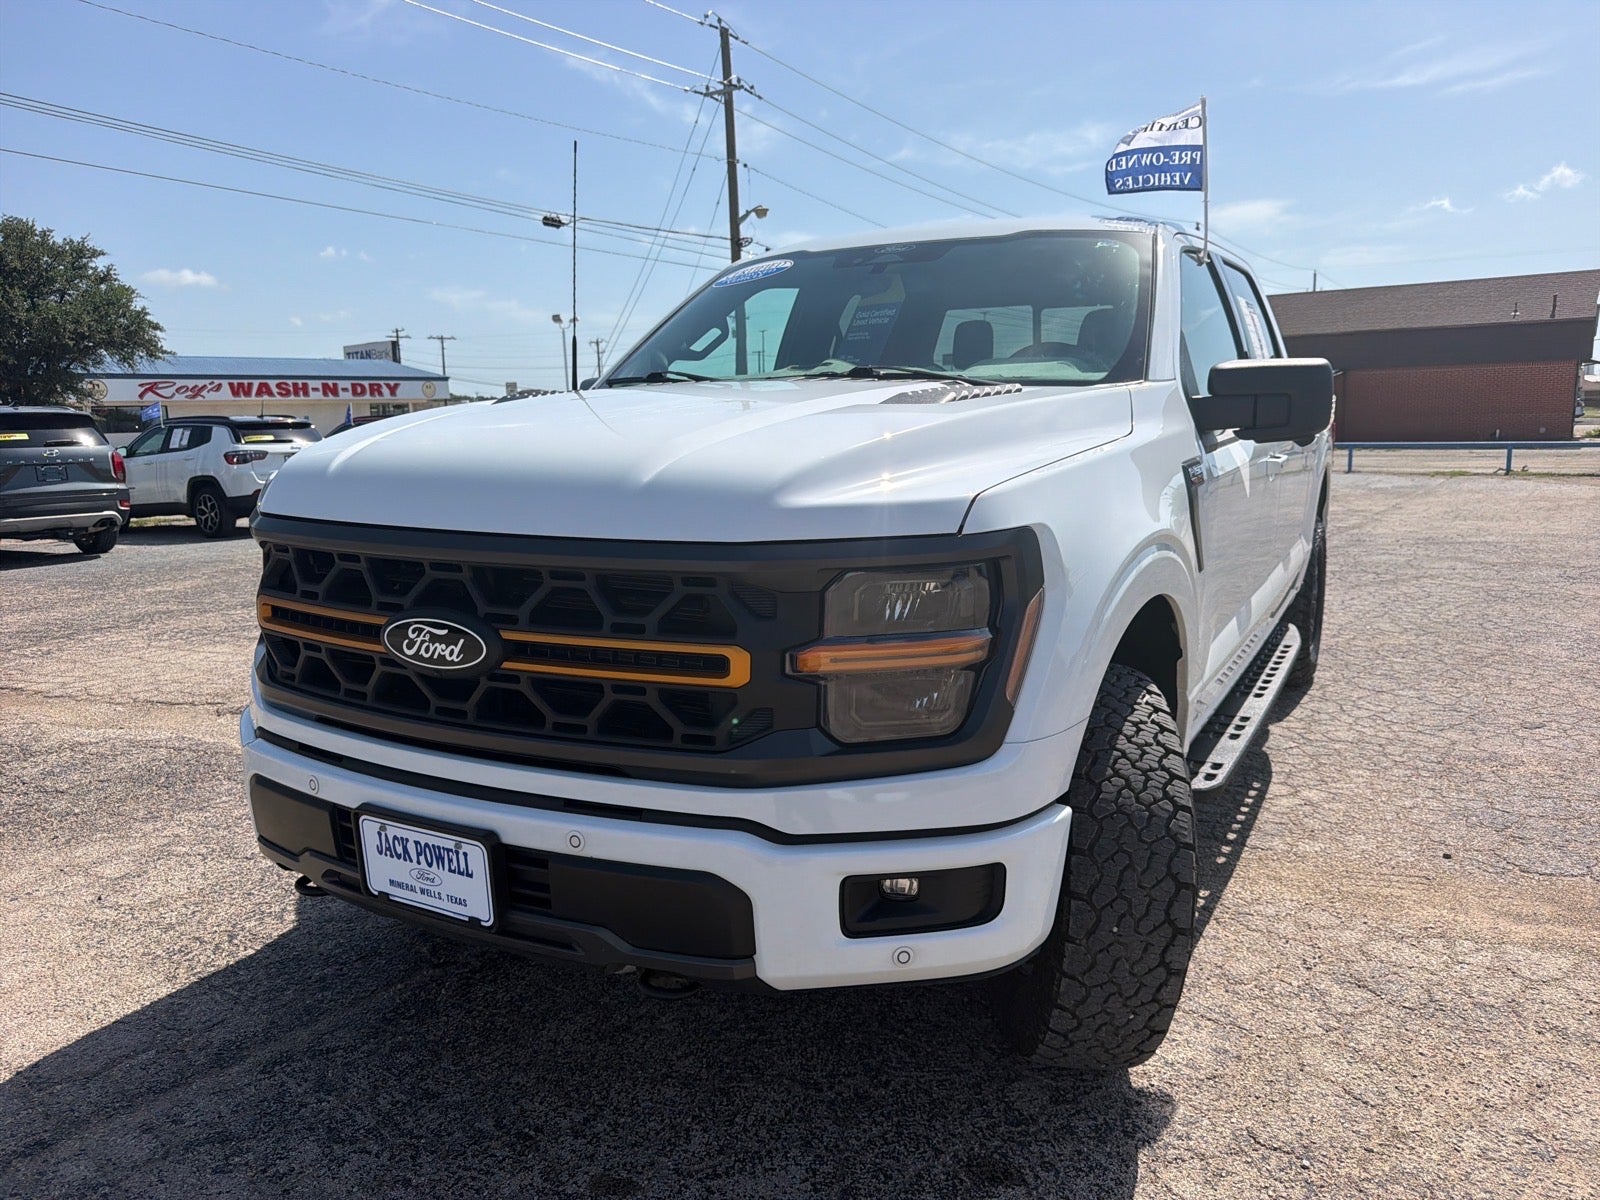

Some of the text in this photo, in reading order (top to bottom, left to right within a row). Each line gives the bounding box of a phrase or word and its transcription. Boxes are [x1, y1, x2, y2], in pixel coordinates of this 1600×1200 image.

[138, 381, 401, 400] Roy's WASH-N-DRY
[402, 624, 465, 662] Ford
[376, 830, 473, 879] JACK POWELL
[415, 871, 436, 884] Ford
[388, 878, 468, 907] MINERAL WELLS, TEXAS
